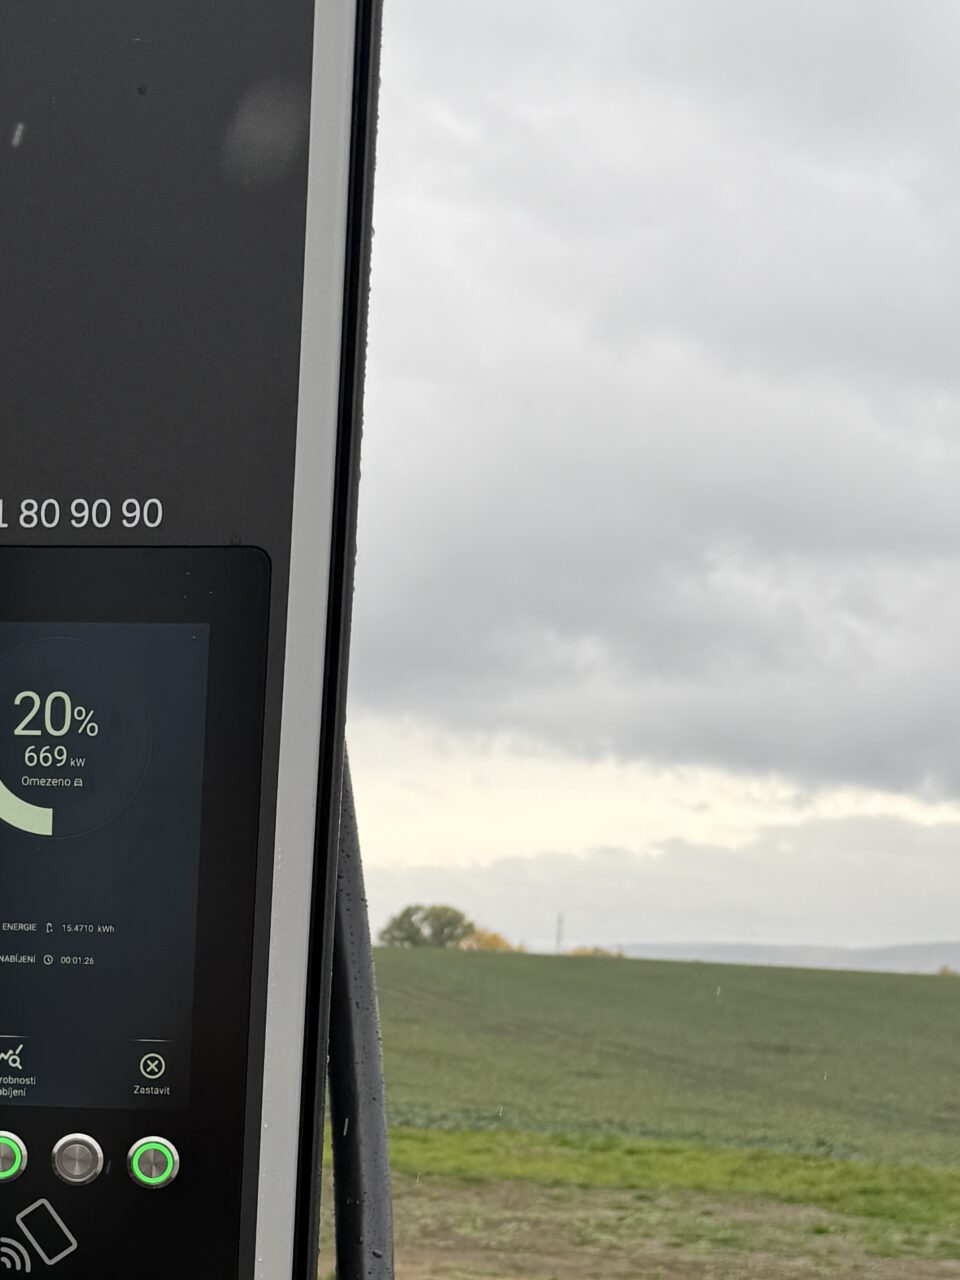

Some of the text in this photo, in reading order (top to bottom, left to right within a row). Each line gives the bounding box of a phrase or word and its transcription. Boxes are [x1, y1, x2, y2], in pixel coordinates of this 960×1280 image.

[18, 499, 60, 528] 80
[70, 499, 111, 528] 90
[121, 499, 163, 528] 90
[13, 690, 99, 737] 20%
[24, 745, 86, 767] 669 kW
[21, 775, 71, 787] Omezeno
[2, 922, 37, 932] ENERGIE
[62, 924, 94, 933] 15.4710
[97, 924, 115, 933] kWh
[133, 1085, 170, 1096] Zastavit
